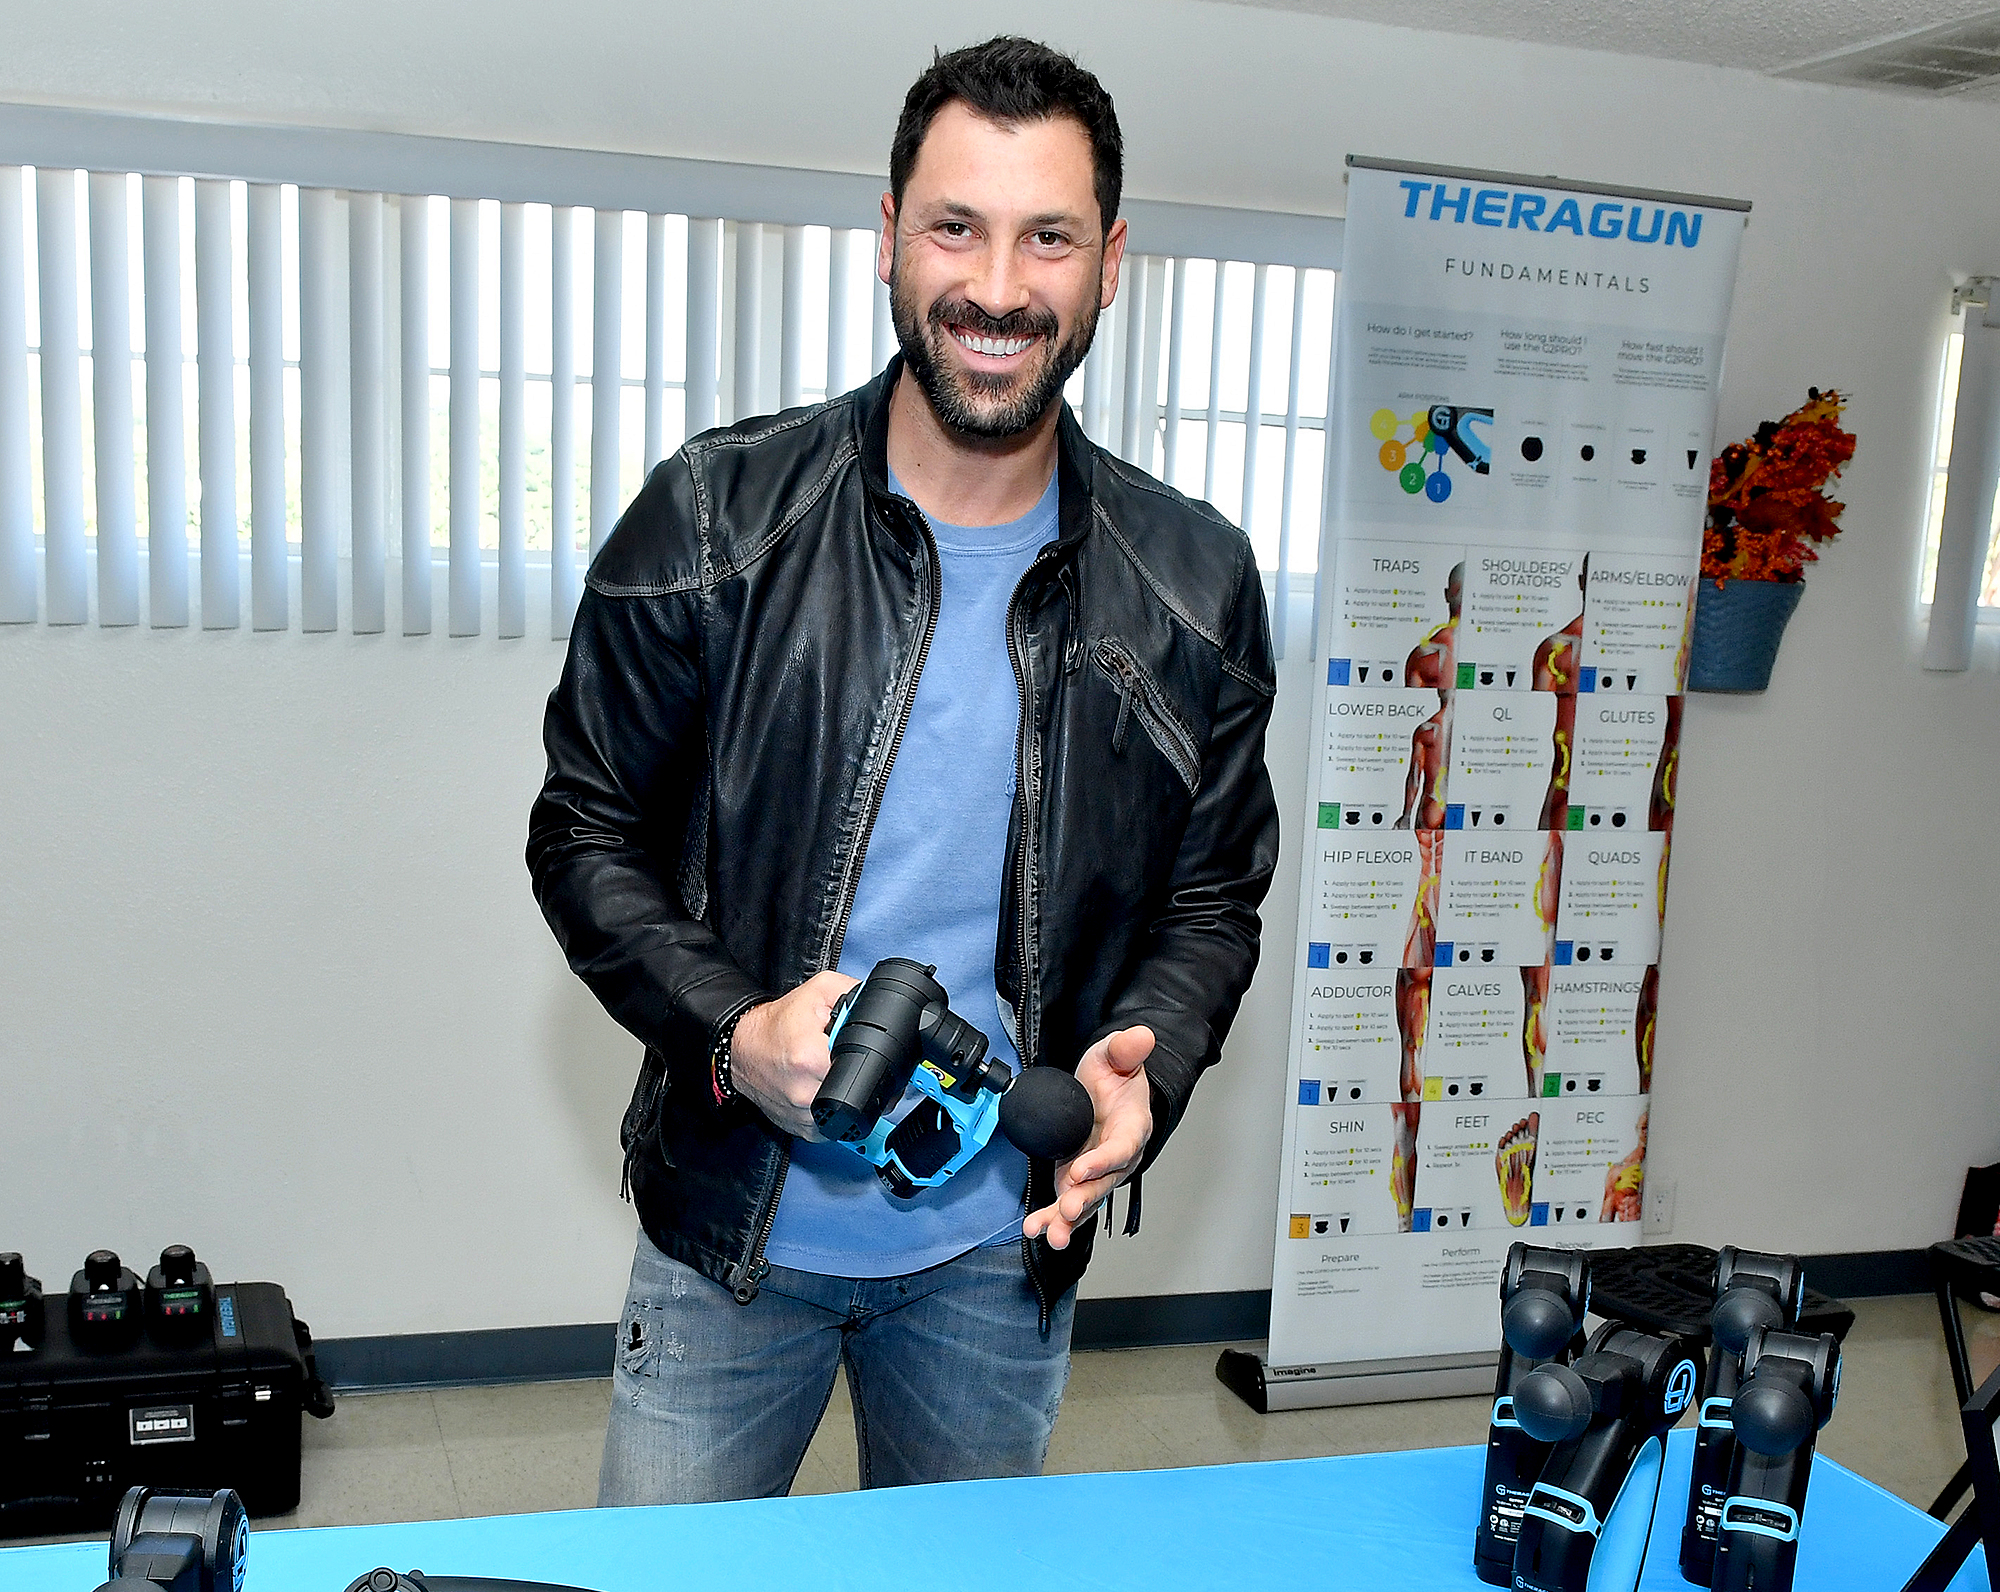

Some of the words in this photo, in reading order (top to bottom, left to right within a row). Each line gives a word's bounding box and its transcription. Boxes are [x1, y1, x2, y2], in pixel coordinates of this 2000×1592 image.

[1399, 180, 1703, 249] THERAGUN
[1445, 258, 1651, 294] FUNDAMENTALS
[1373, 559, 1420, 574] TRAPS
[1482, 559, 1573, 575] SHOULDERS/
[1490, 573, 1562, 588] ROTATORS
[1591, 570, 1690, 586] ARMS/ELBOW
[1329, 703, 1385, 716] LOWER
[1388, 705, 1425, 717] BACK
[1493, 707, 1512, 722] QL
[1600, 710, 1655, 724] GLUTES
[1324, 851, 1352, 863] HIP
[1356, 851, 1413, 864] FLEXOR
[1464, 851, 1477, 863] IT
[1480, 851, 1523, 863] BAND
[1588, 851, 1641, 866] QUADS
[1311, 986, 1393, 998] ADDUCTOR
[1447, 984, 1501, 996] CALVES
[1554, 982, 1640, 993] HAMSTRINGS
[1455, 1116, 1490, 1128] FEET
[1576, 1112, 1604, 1123] PEC
[1330, 1121, 1364, 1133] SHIN
[1321, 1254, 1360, 1263] Prepare
[1442, 1248, 1480, 1257] Perform
